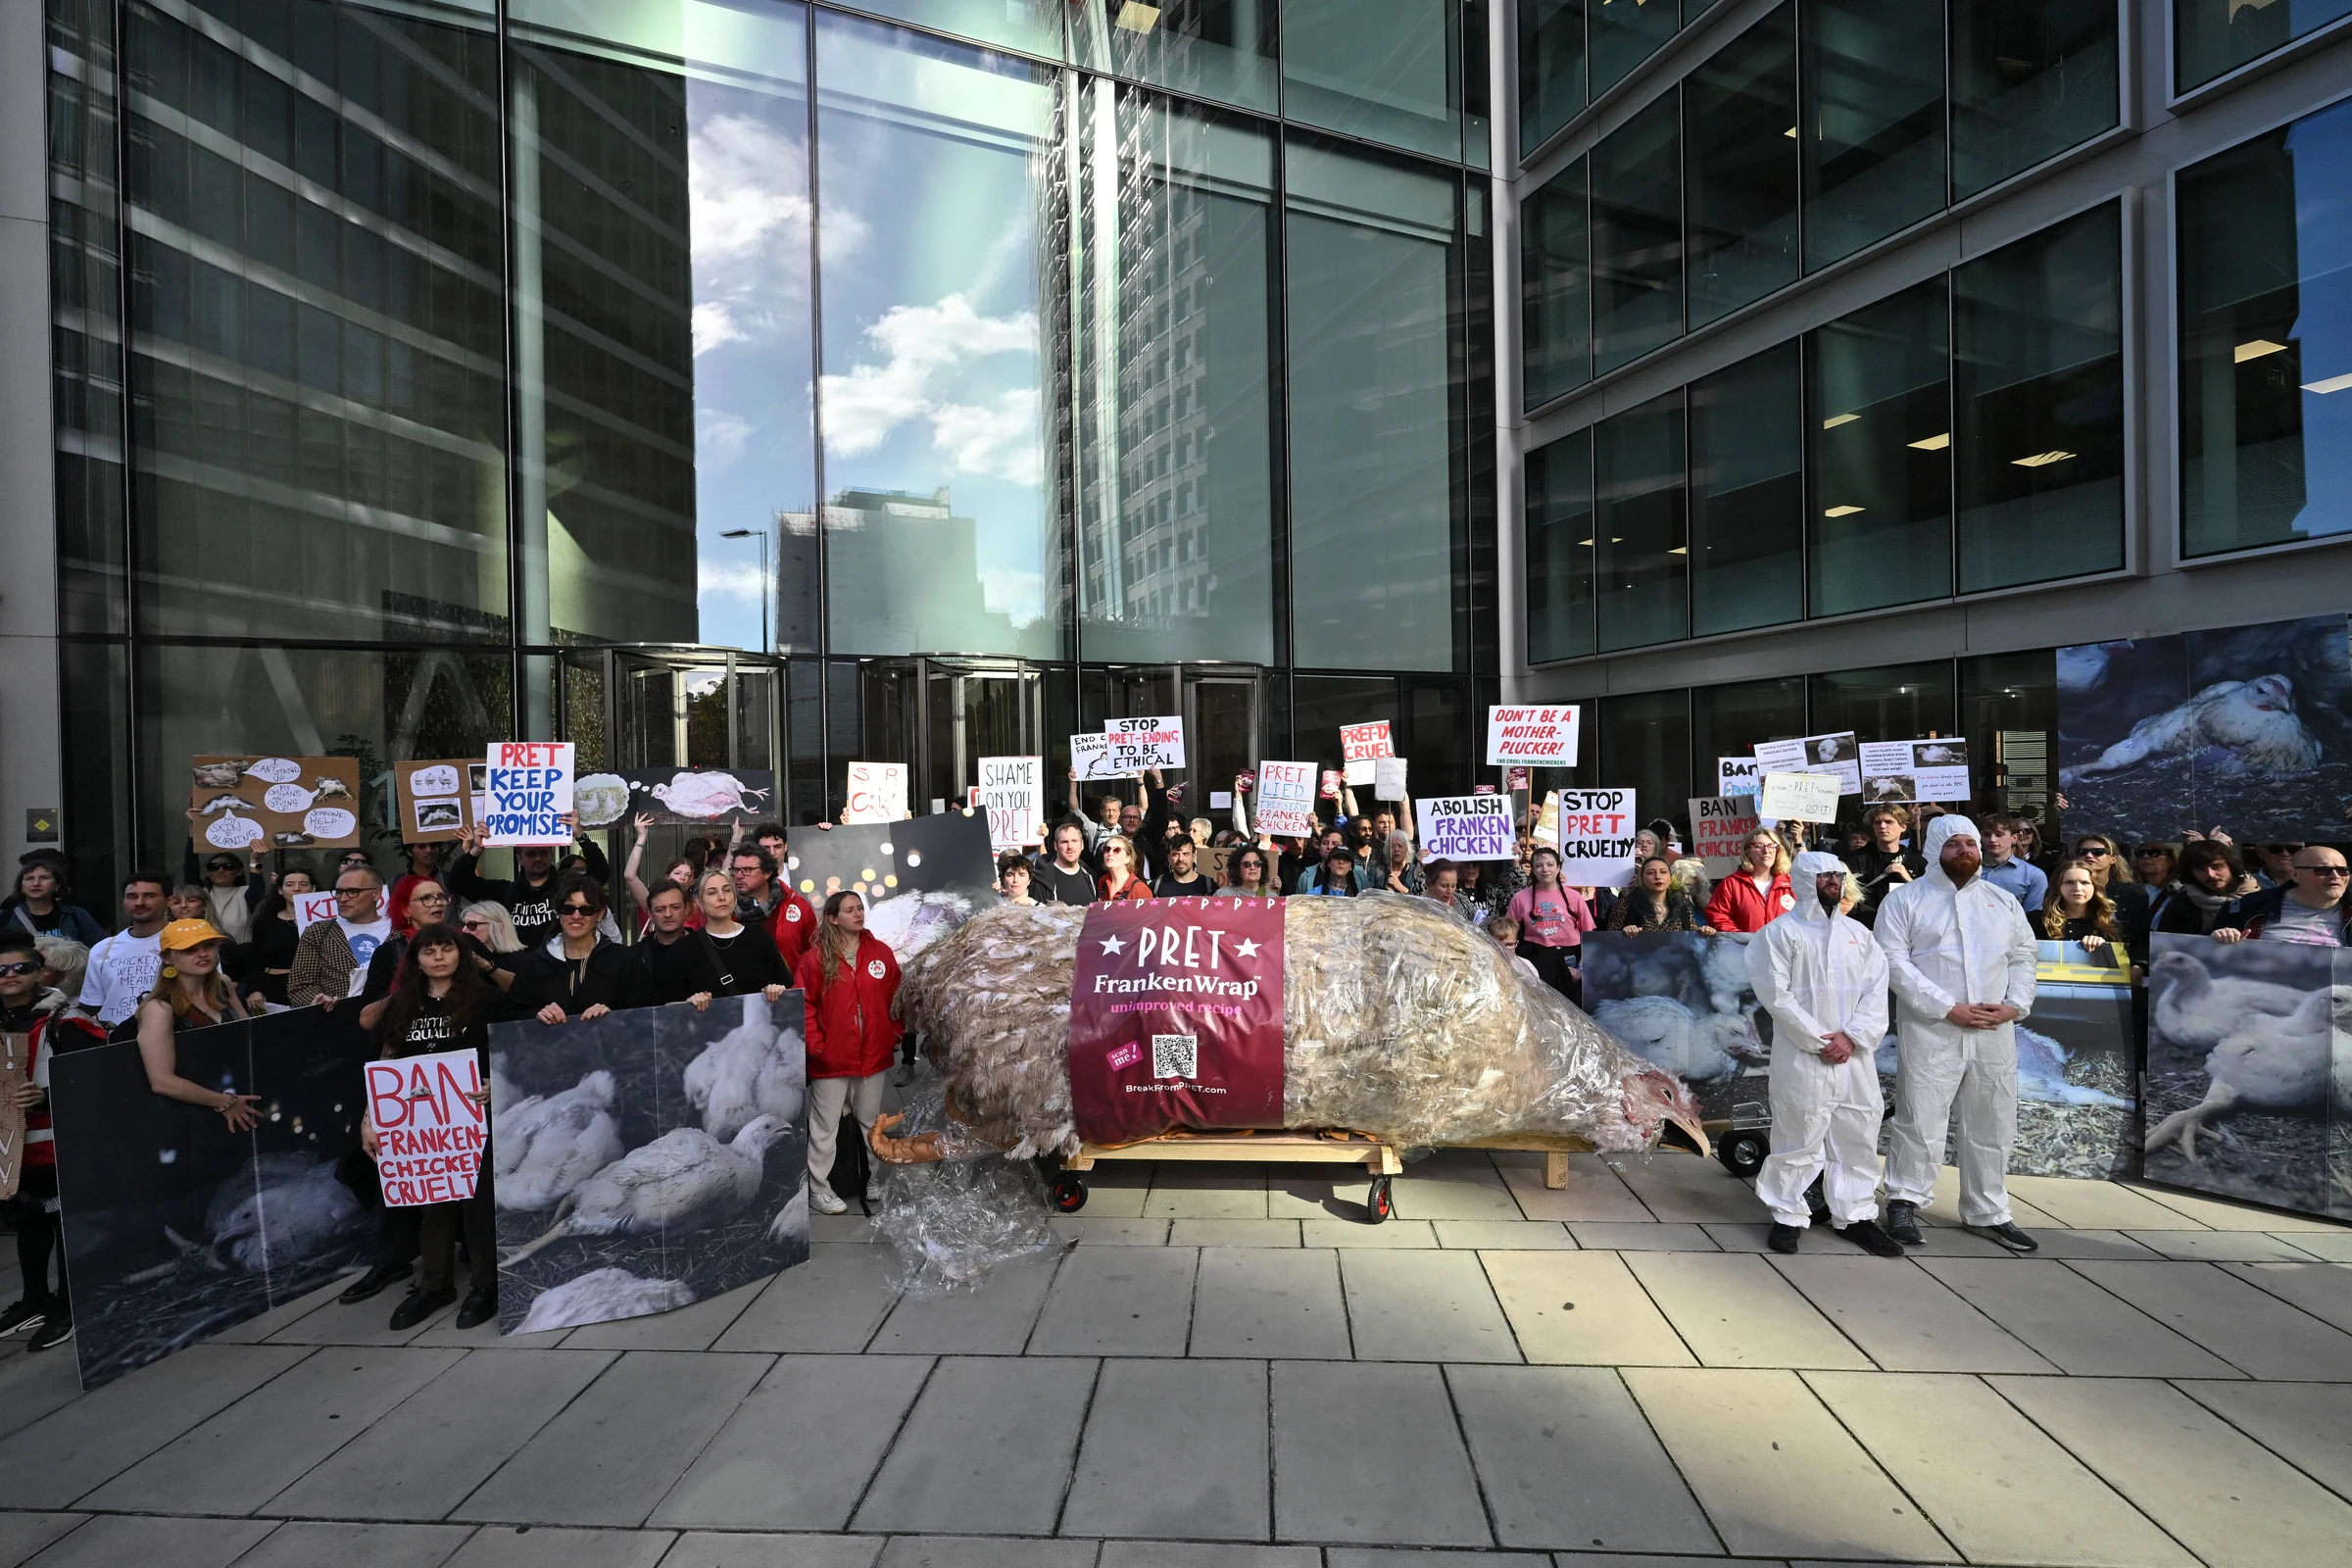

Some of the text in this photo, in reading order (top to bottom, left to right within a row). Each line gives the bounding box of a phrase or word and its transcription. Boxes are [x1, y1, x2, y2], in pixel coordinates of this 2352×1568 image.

[1495, 710, 1572, 722] DON'T BE A
[1119, 718, 1159, 732] STOP
[1501, 725, 1562, 739] MOTHER-
[1074, 736, 1096, 745] END
[1108, 730, 1180, 745] PRET-ENDING
[501, 743, 565, 767] PRET
[1116, 744, 1159, 756] TO BE
[1344, 742, 1396, 760] CRUEL
[1499, 741, 1565, 755] PLUCKER!
[1113, 753, 1174, 769] ETHICAL
[490, 768, 563, 791] KEEP
[986, 761, 1033, 786] SHAME
[1265, 764, 1307, 783] PRET
[1262, 782, 1303, 798] LIED
[494, 792, 557, 812] YOUR
[986, 792, 1004, 809] ON
[1284, 802, 1309, 811] SERVE
[1431, 799, 1502, 816] ABOLISH
[1564, 792, 1623, 810] STOP
[1700, 800, 1737, 816] BAN
[1260, 809, 1309, 821] FRANKEN
[486, 813, 572, 837] PROMISE!
[991, 808, 1032, 842] PRET
[1258, 819, 1309, 832] CHICKEN
[1436, 815, 1509, 836] FRANKEN
[1567, 814, 1626, 836] PRET
[1699, 816, 1757, 838] FRANKEN
[212, 831, 258, 847] BURNING
[1428, 836, 1502, 855] CHICKEN
[1564, 838, 1636, 858] CRUELTY
[1103, 898, 1276, 910] P P P P P P
[1138, 925, 1225, 969] PRET
[109, 1007, 133, 1017] THIS
[1110, 1000, 1243, 1017] unimproved recipe
[1111, 1047, 1129, 1059] scan
[368, 1060, 483, 1127] BAN
[1126, 1081, 1227, 1096] BreakFromPRET.com
[376, 1123, 488, 1156] FRANKEN-
[384, 1173, 479, 1205] CRUELT
